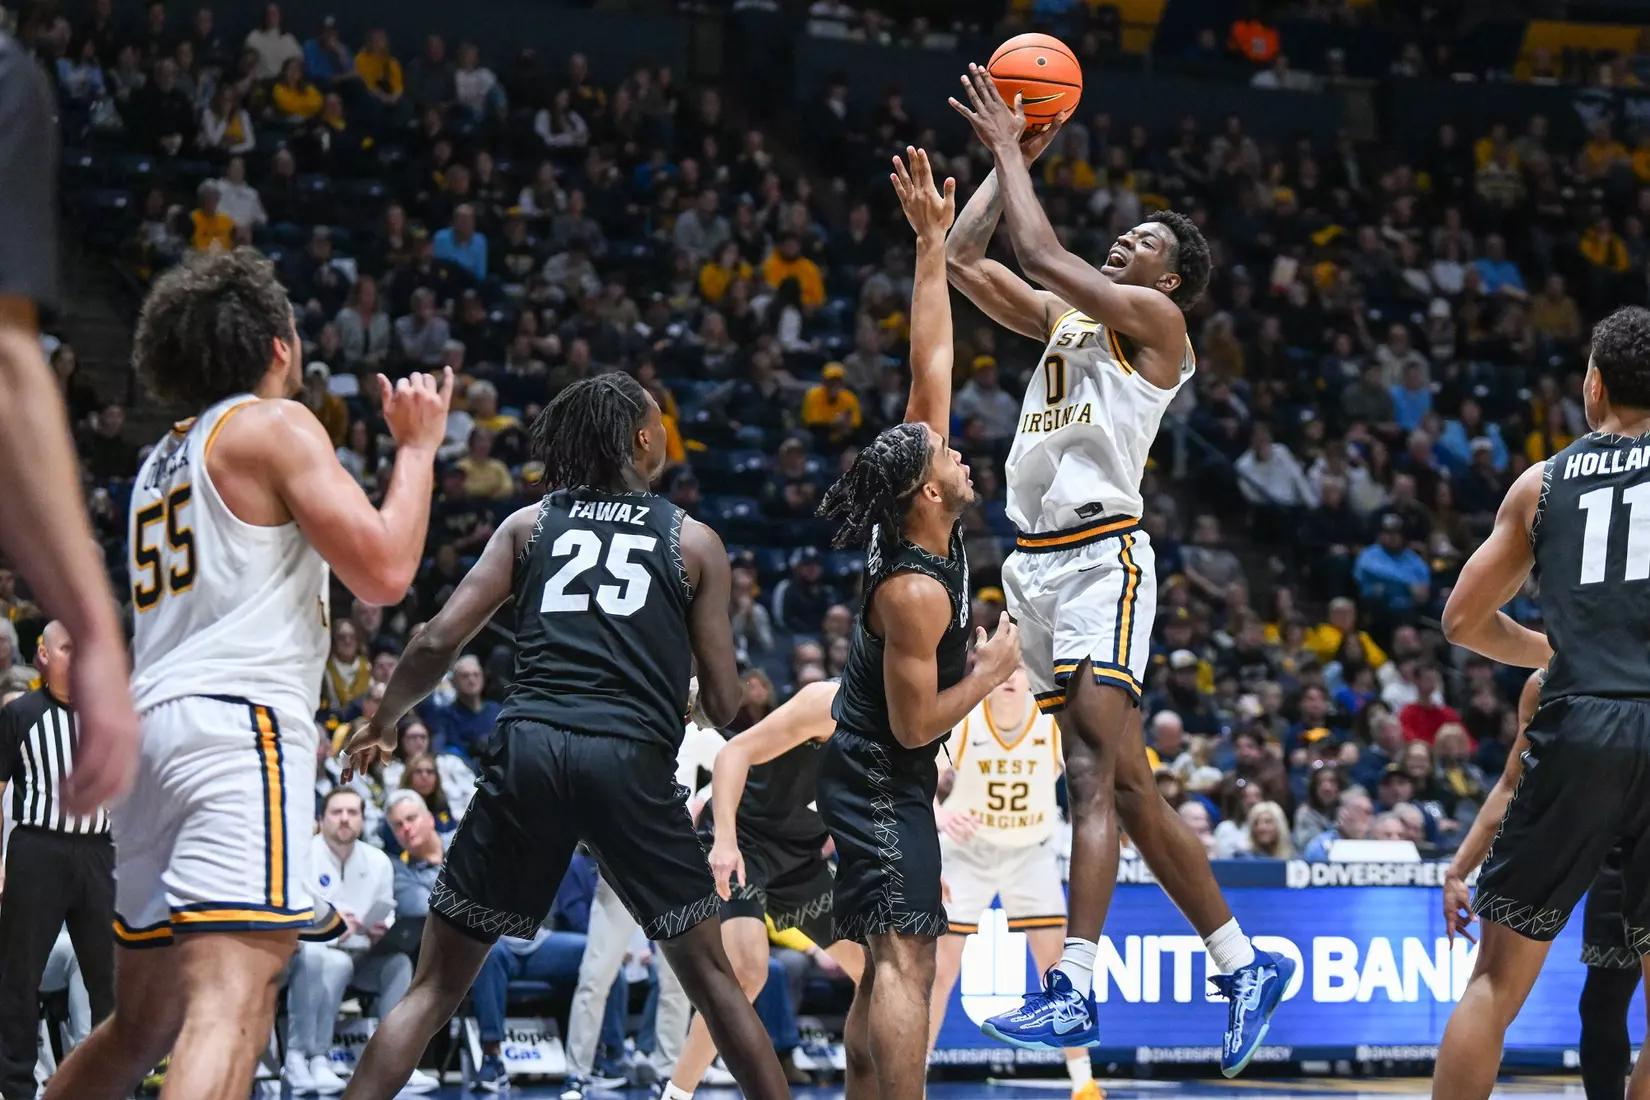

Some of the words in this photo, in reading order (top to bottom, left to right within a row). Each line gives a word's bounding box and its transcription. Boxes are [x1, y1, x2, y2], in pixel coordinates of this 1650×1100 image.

[1044, 352, 1065, 406] 0
[1021, 402, 1092, 433] IRGINIA
[568, 500, 650, 526] FAWAZ
[133, 482, 198, 613] 55
[1578, 480, 1650, 585] 11
[540, 529, 657, 617] 25
[977, 758, 1038, 776] WEST
[987, 782, 1029, 812] 52
[504, 1046, 542, 1061] Gas
